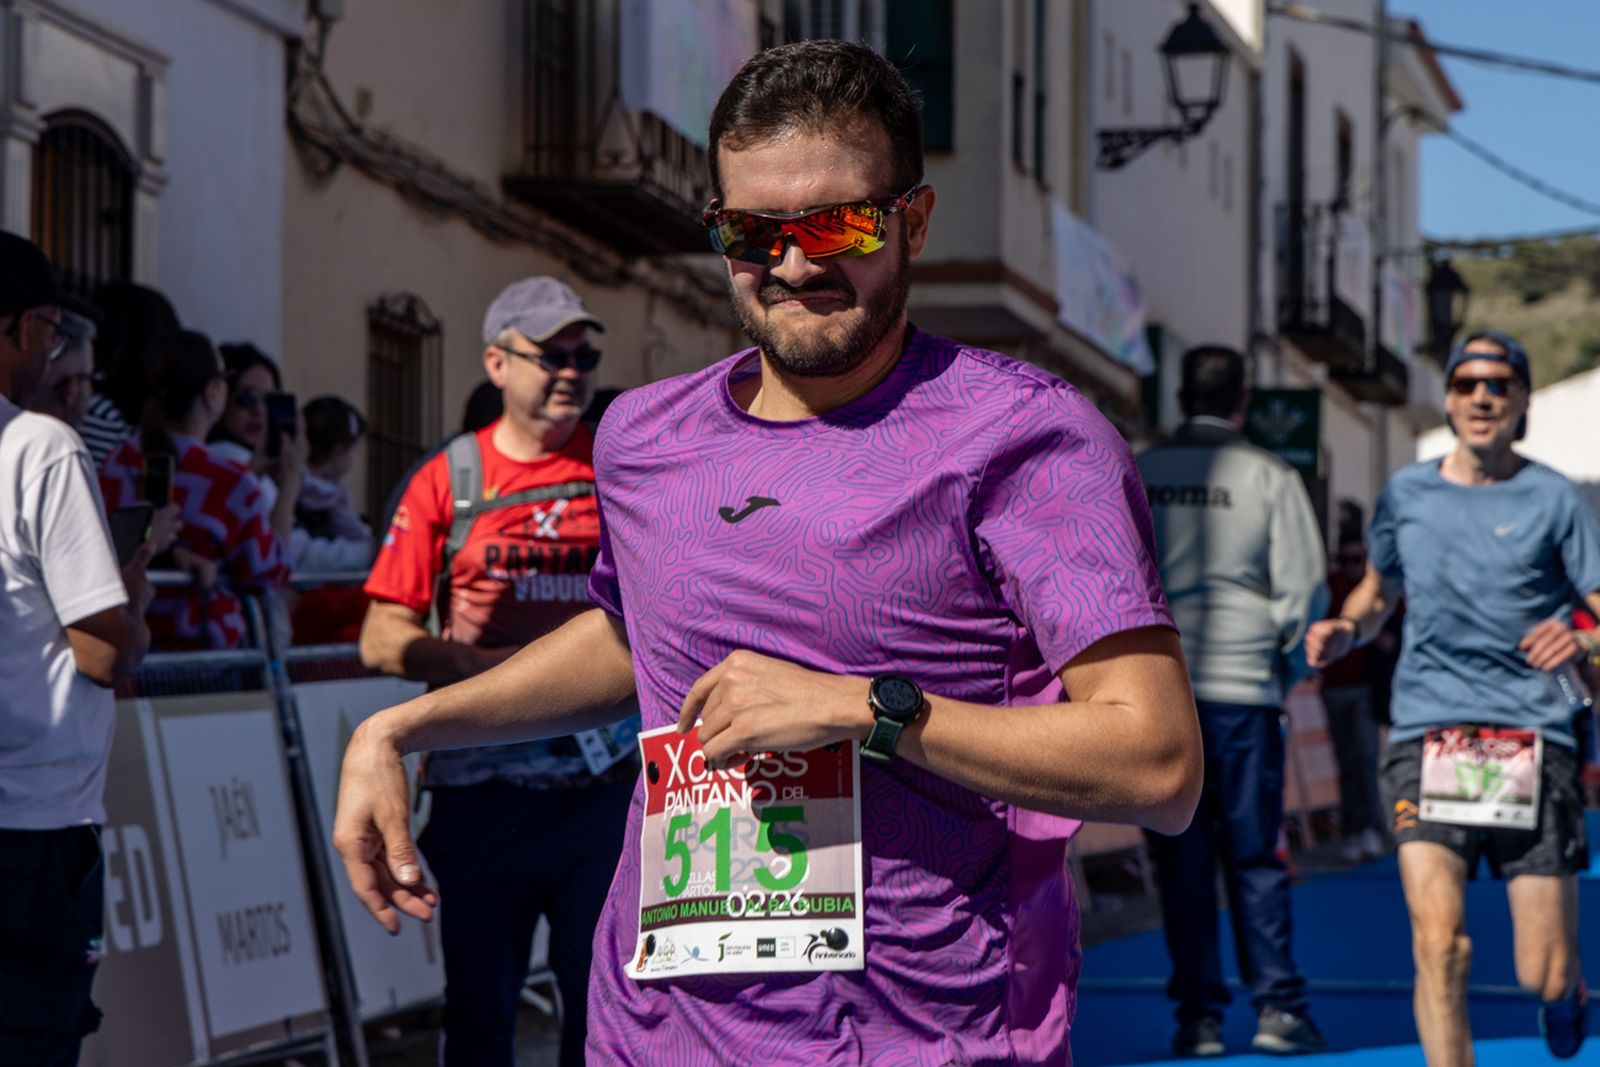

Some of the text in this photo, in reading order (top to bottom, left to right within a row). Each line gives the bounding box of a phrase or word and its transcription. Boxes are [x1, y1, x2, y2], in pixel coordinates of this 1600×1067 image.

[663, 739, 686, 789] X
[663, 780, 808, 820] PANTANO DEL
[663, 806, 809, 898] 515
[101, 823, 163, 953] ED
[641, 906, 677, 925] ANTONIO
[679, 897, 737, 918] MANUEL
[216, 902, 292, 966] MARTOS
